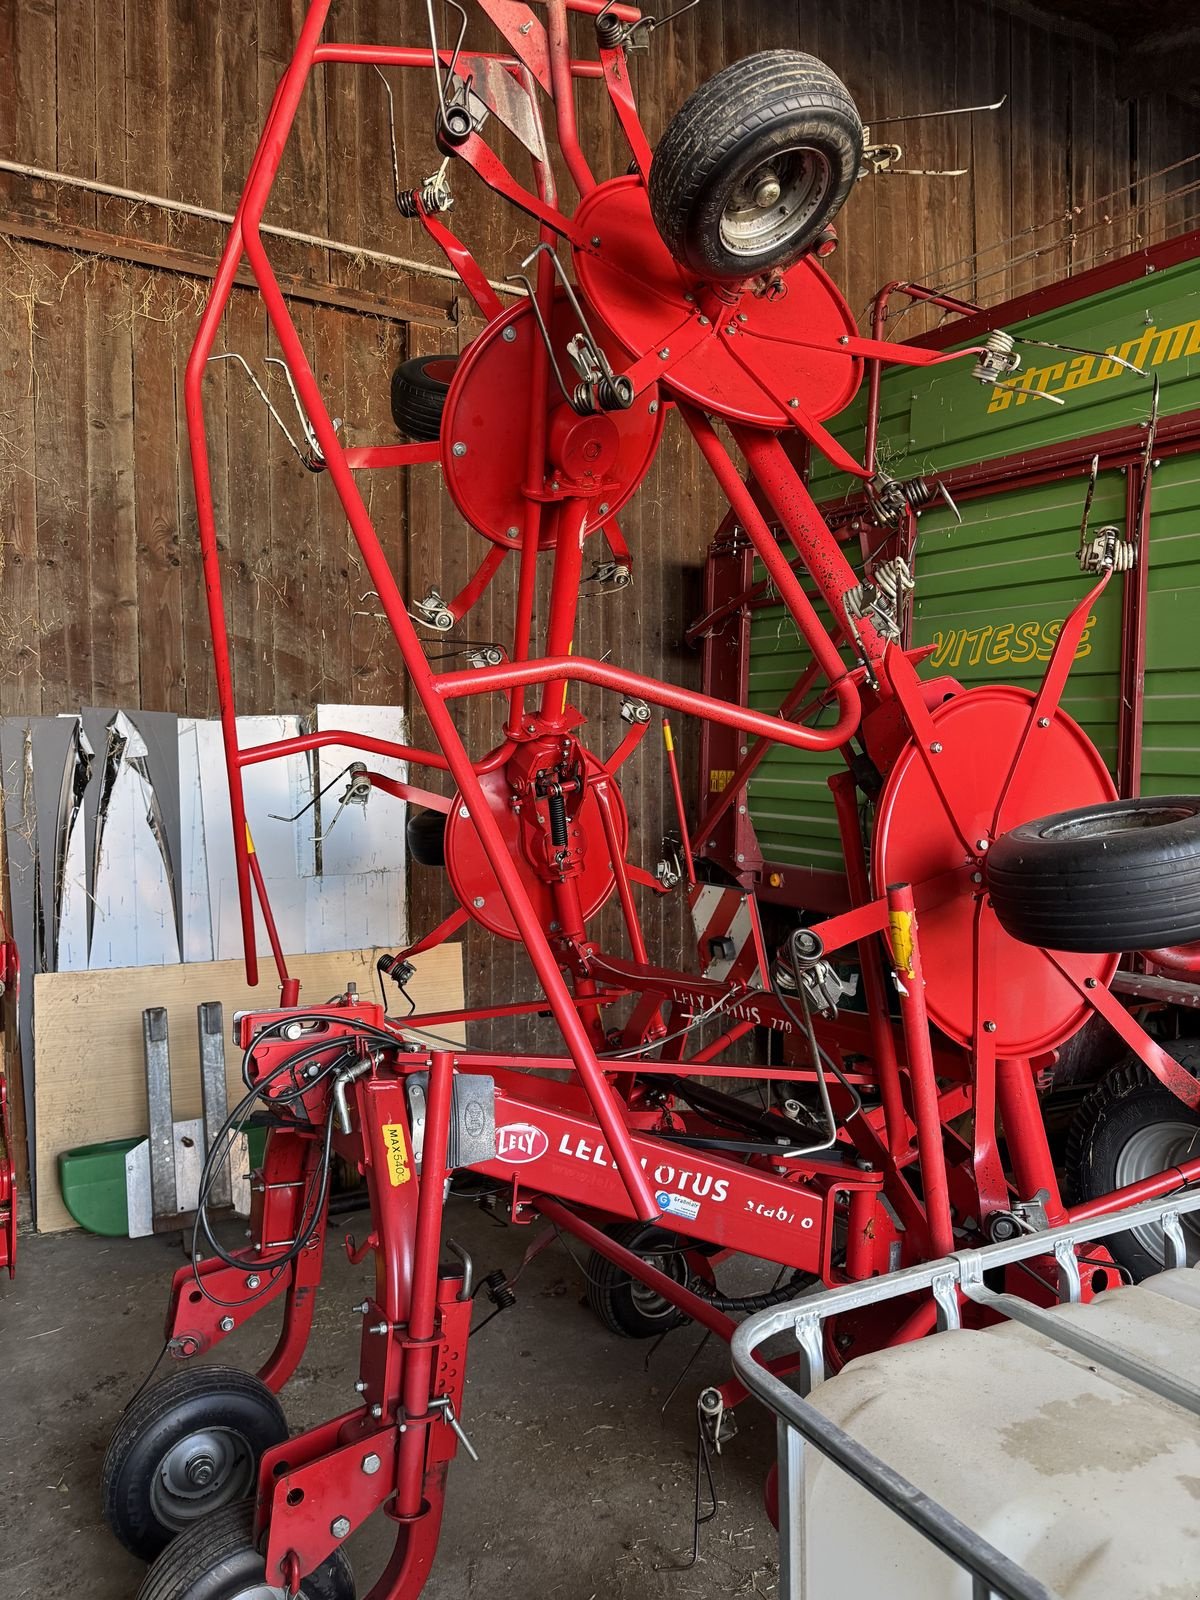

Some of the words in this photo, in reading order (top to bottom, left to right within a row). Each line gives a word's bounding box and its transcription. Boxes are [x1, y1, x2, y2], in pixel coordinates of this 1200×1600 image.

[771, 1017, 792, 1034] 770
[498, 1129, 537, 1156] LELY
[558, 1134, 618, 1169] LEL
